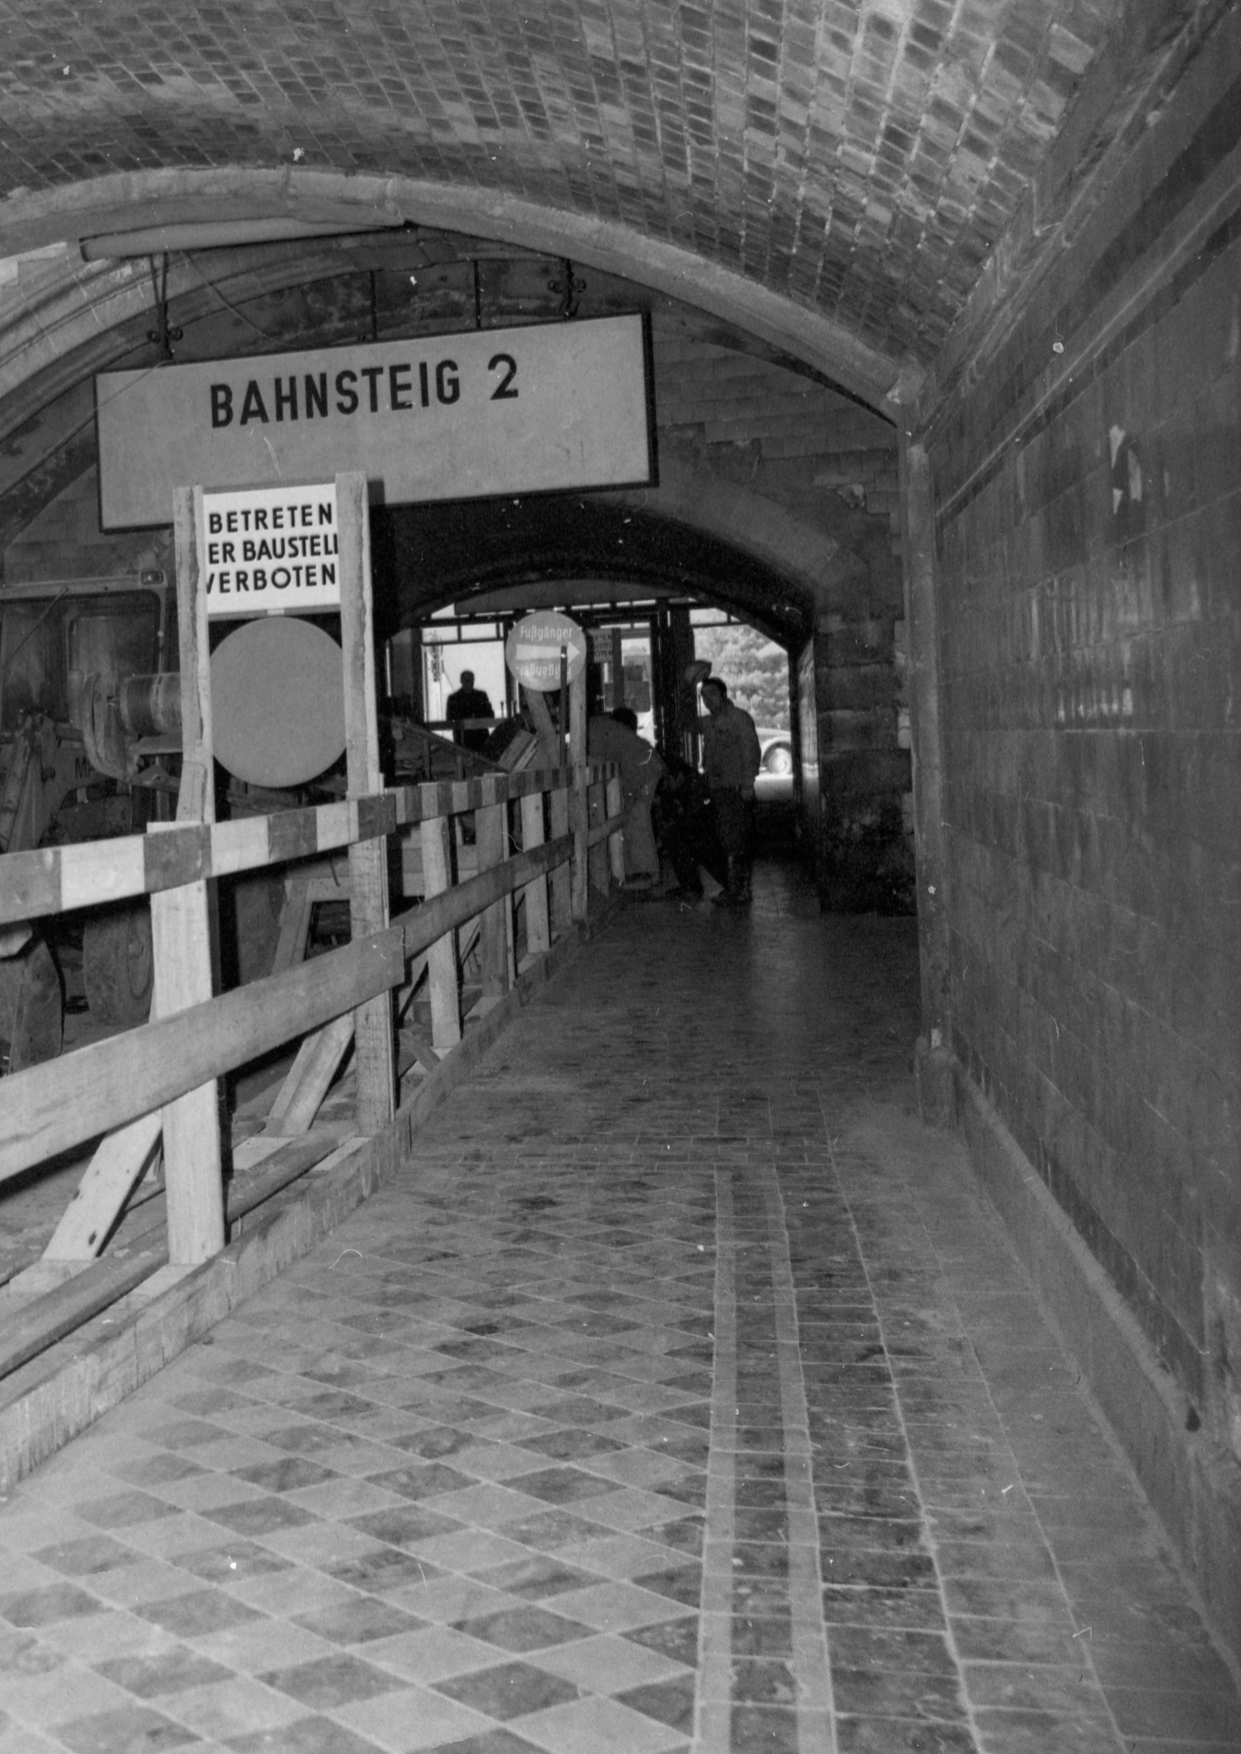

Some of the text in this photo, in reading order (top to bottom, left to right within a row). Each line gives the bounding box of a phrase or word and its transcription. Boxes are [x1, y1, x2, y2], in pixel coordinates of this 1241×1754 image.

[210, 353, 519, 429] BAHNSTEIG 2
[208, 502, 333, 535] BETRETEN
[208, 533, 339, 565] ER BAUSTELL
[520, 625, 573, 641] Fußgänger
